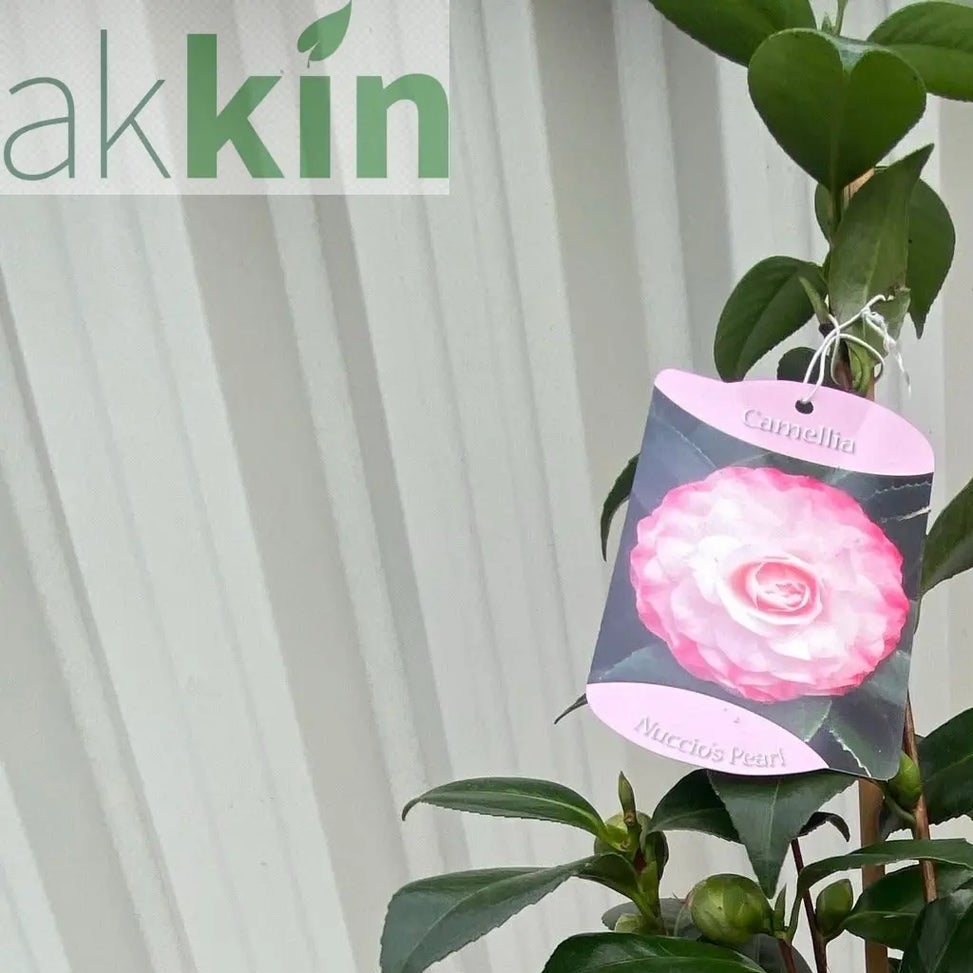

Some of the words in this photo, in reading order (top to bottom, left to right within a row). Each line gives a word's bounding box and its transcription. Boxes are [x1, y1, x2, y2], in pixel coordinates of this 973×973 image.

[743, 409, 856, 454] Camellia
[634, 716, 725, 763] Nuccio's
[729, 746, 787, 768] Pearl
